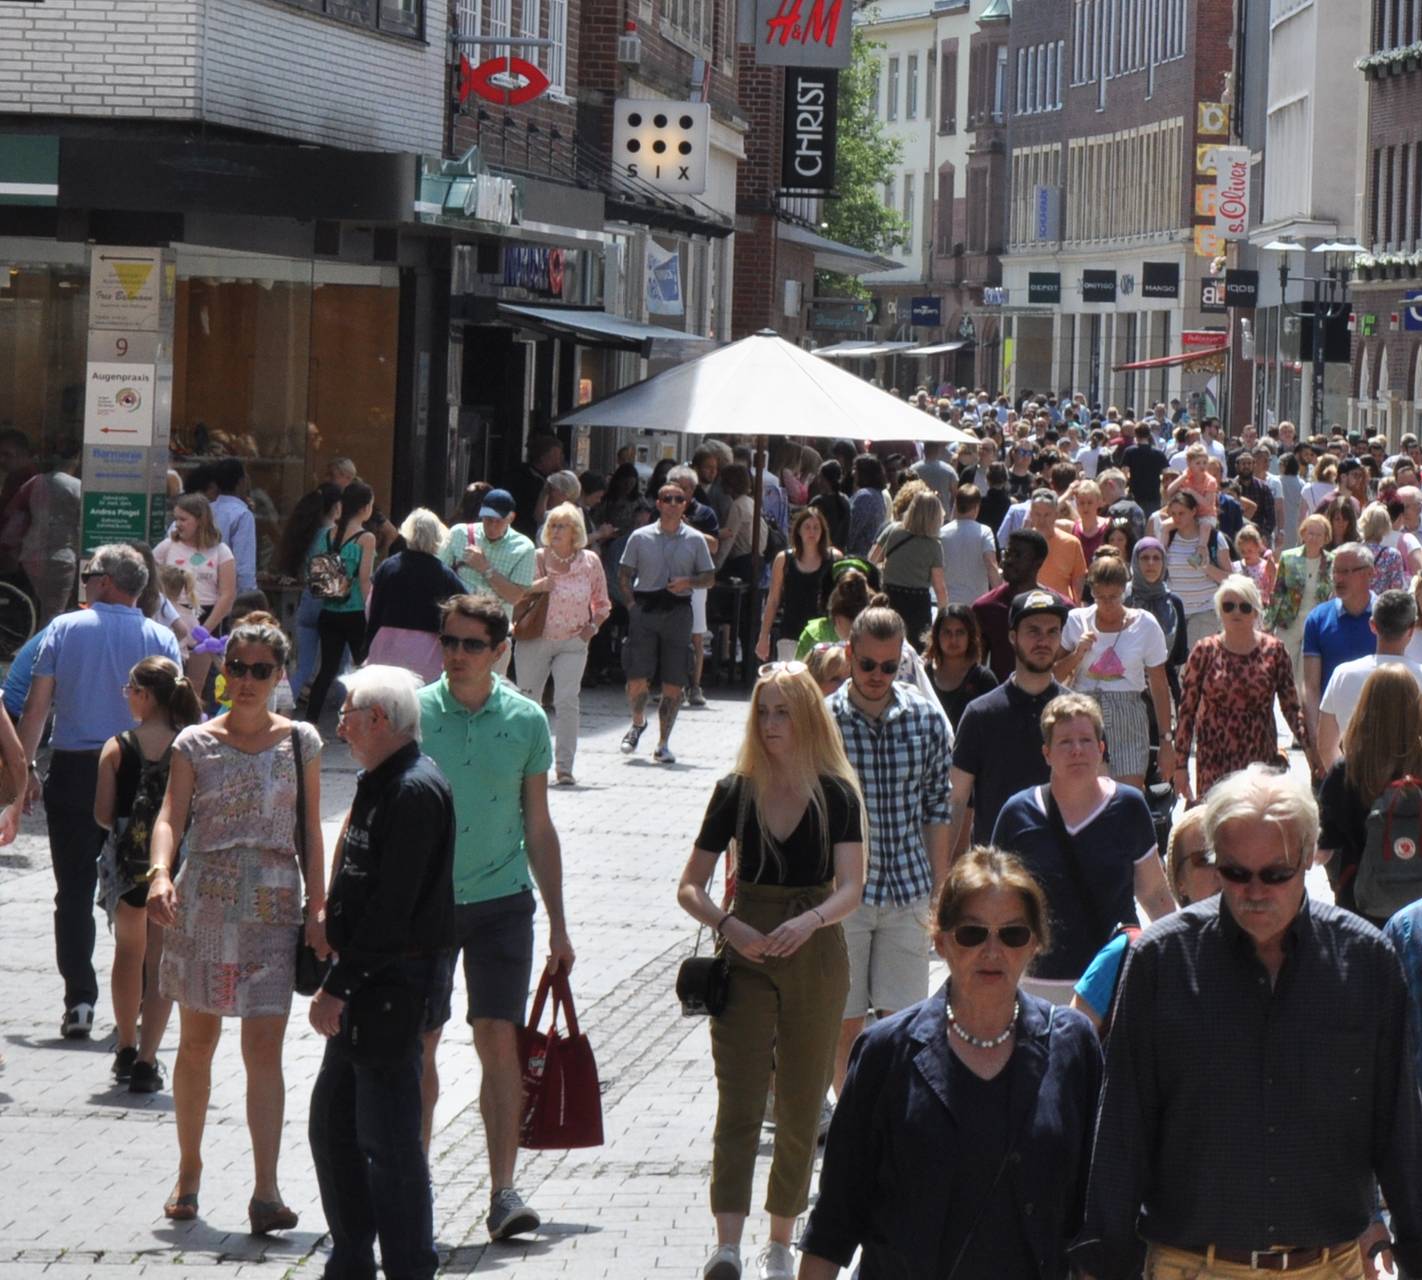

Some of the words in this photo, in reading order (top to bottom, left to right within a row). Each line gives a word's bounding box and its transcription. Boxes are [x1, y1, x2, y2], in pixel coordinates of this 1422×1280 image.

[767, 0, 843, 47] H&M
[794, 77, 825, 177] CHRIST
[626, 164, 690, 182] SIX
[1219, 161, 1248, 234] s.Oliver
[1030, 284, 1059, 292] DEPOT
[1145, 284, 1176, 292] MANGO
[115, 338, 128, 357] 9
[92, 372, 150, 382] Augenpraxis
